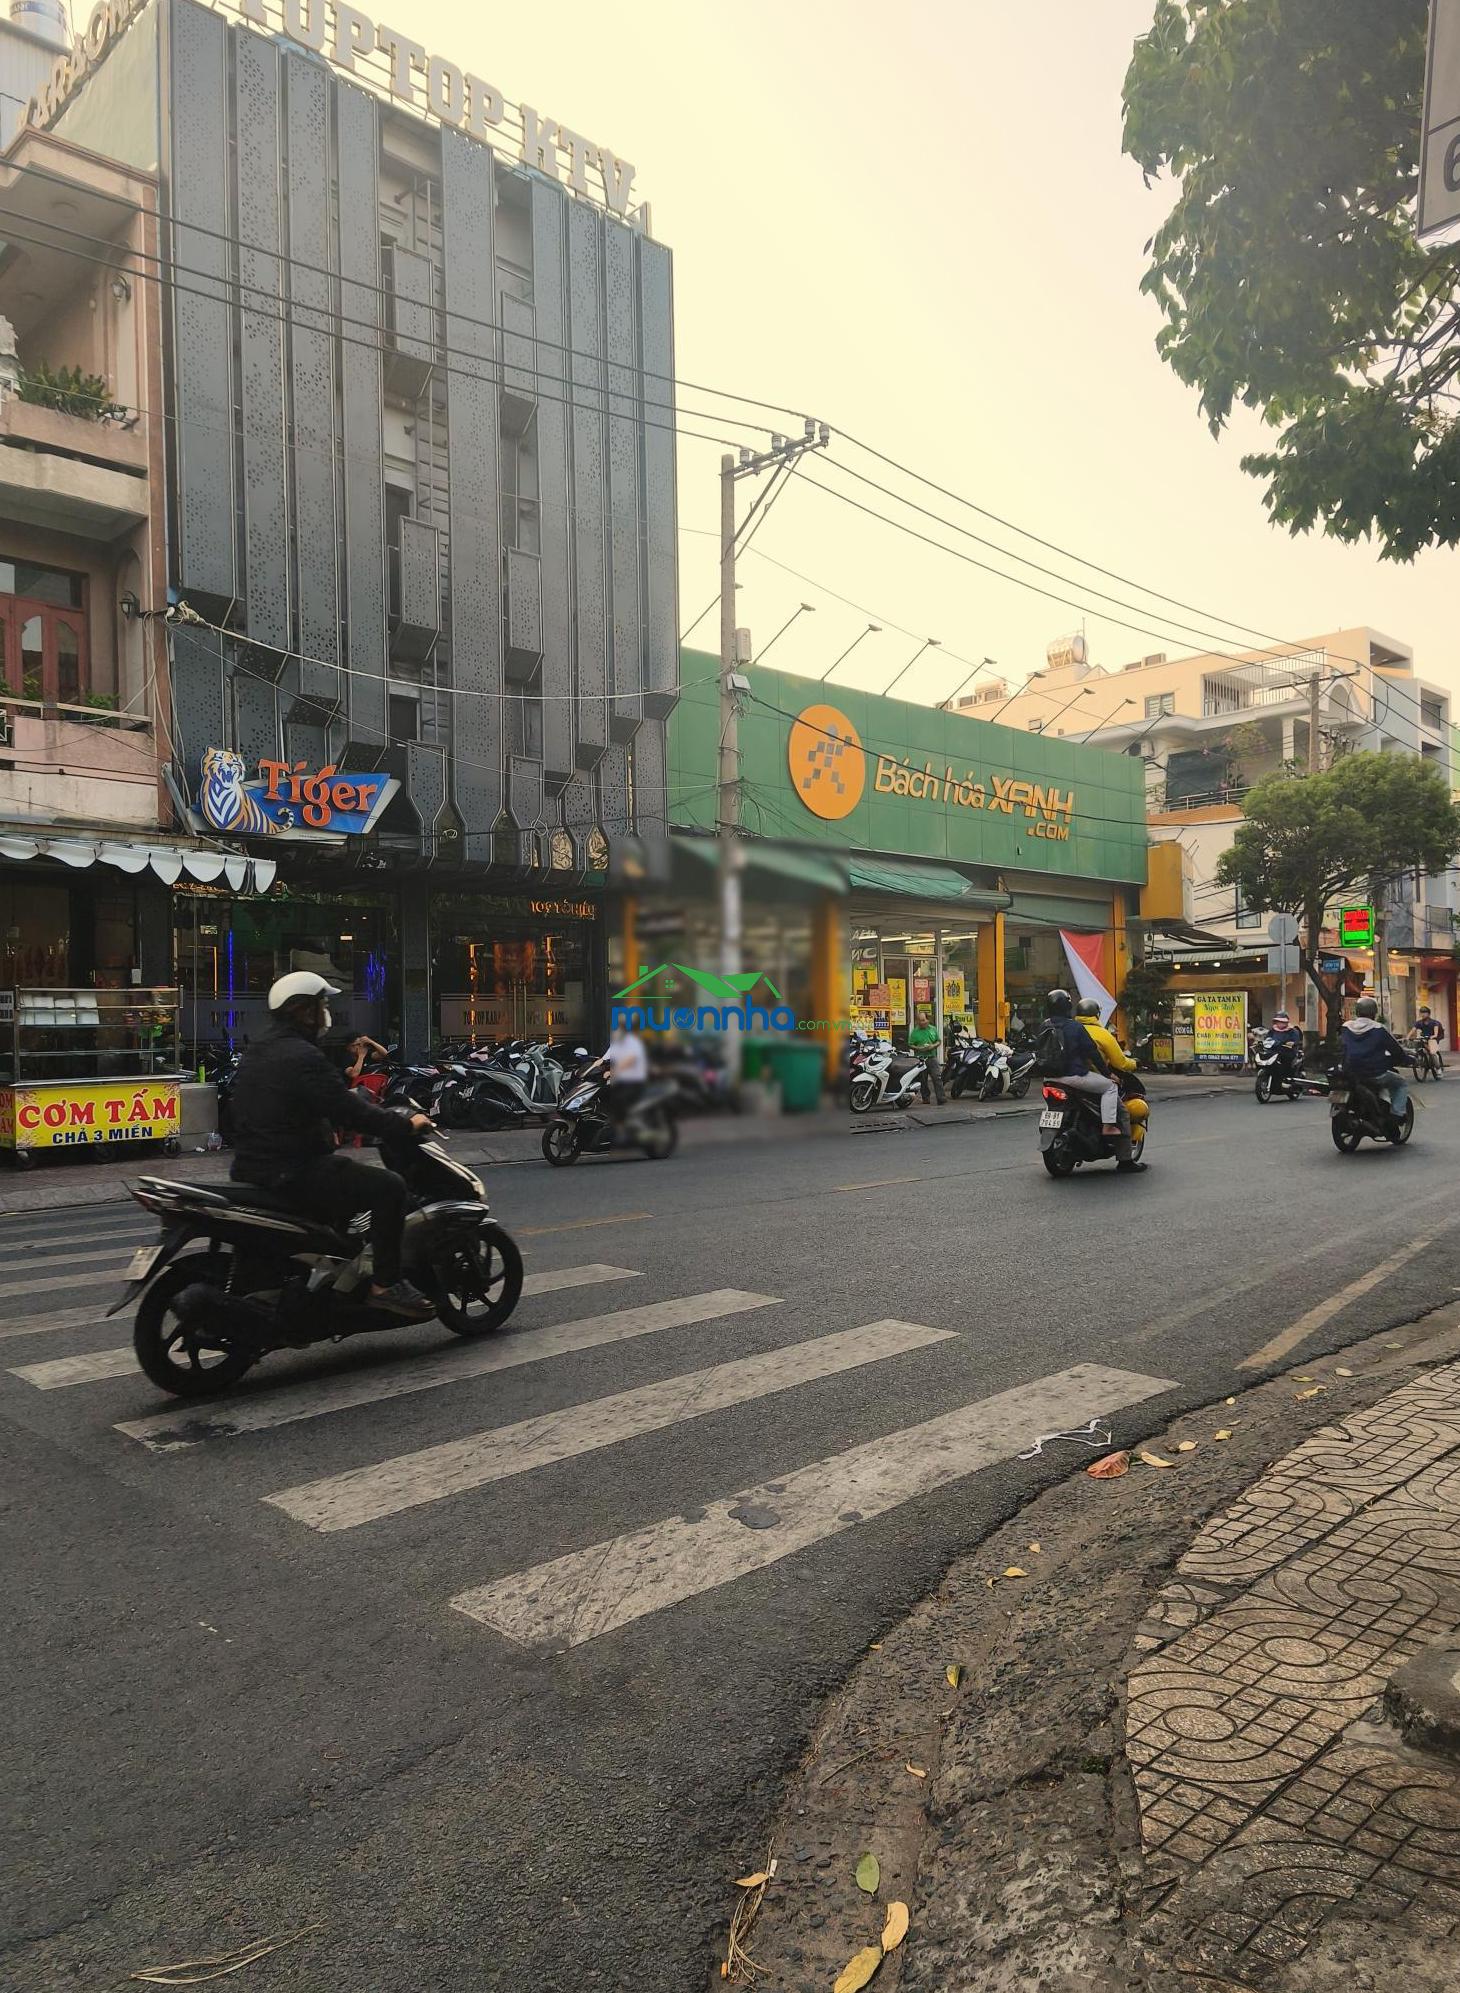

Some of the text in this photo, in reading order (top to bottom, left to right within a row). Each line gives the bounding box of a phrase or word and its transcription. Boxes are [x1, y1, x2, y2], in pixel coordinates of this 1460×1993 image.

[519, 103, 637, 215] KTV
[257, 758, 378, 827] Tiger
[874, 753, 1075, 824] Bách hóa XANH
[1027, 821, 1070, 842] .COM
[18, 1088, 177, 1129] CƠM TẤM
[52, 1127, 88, 1144] CHẢ
[93, 1130, 103, 1141] 3
